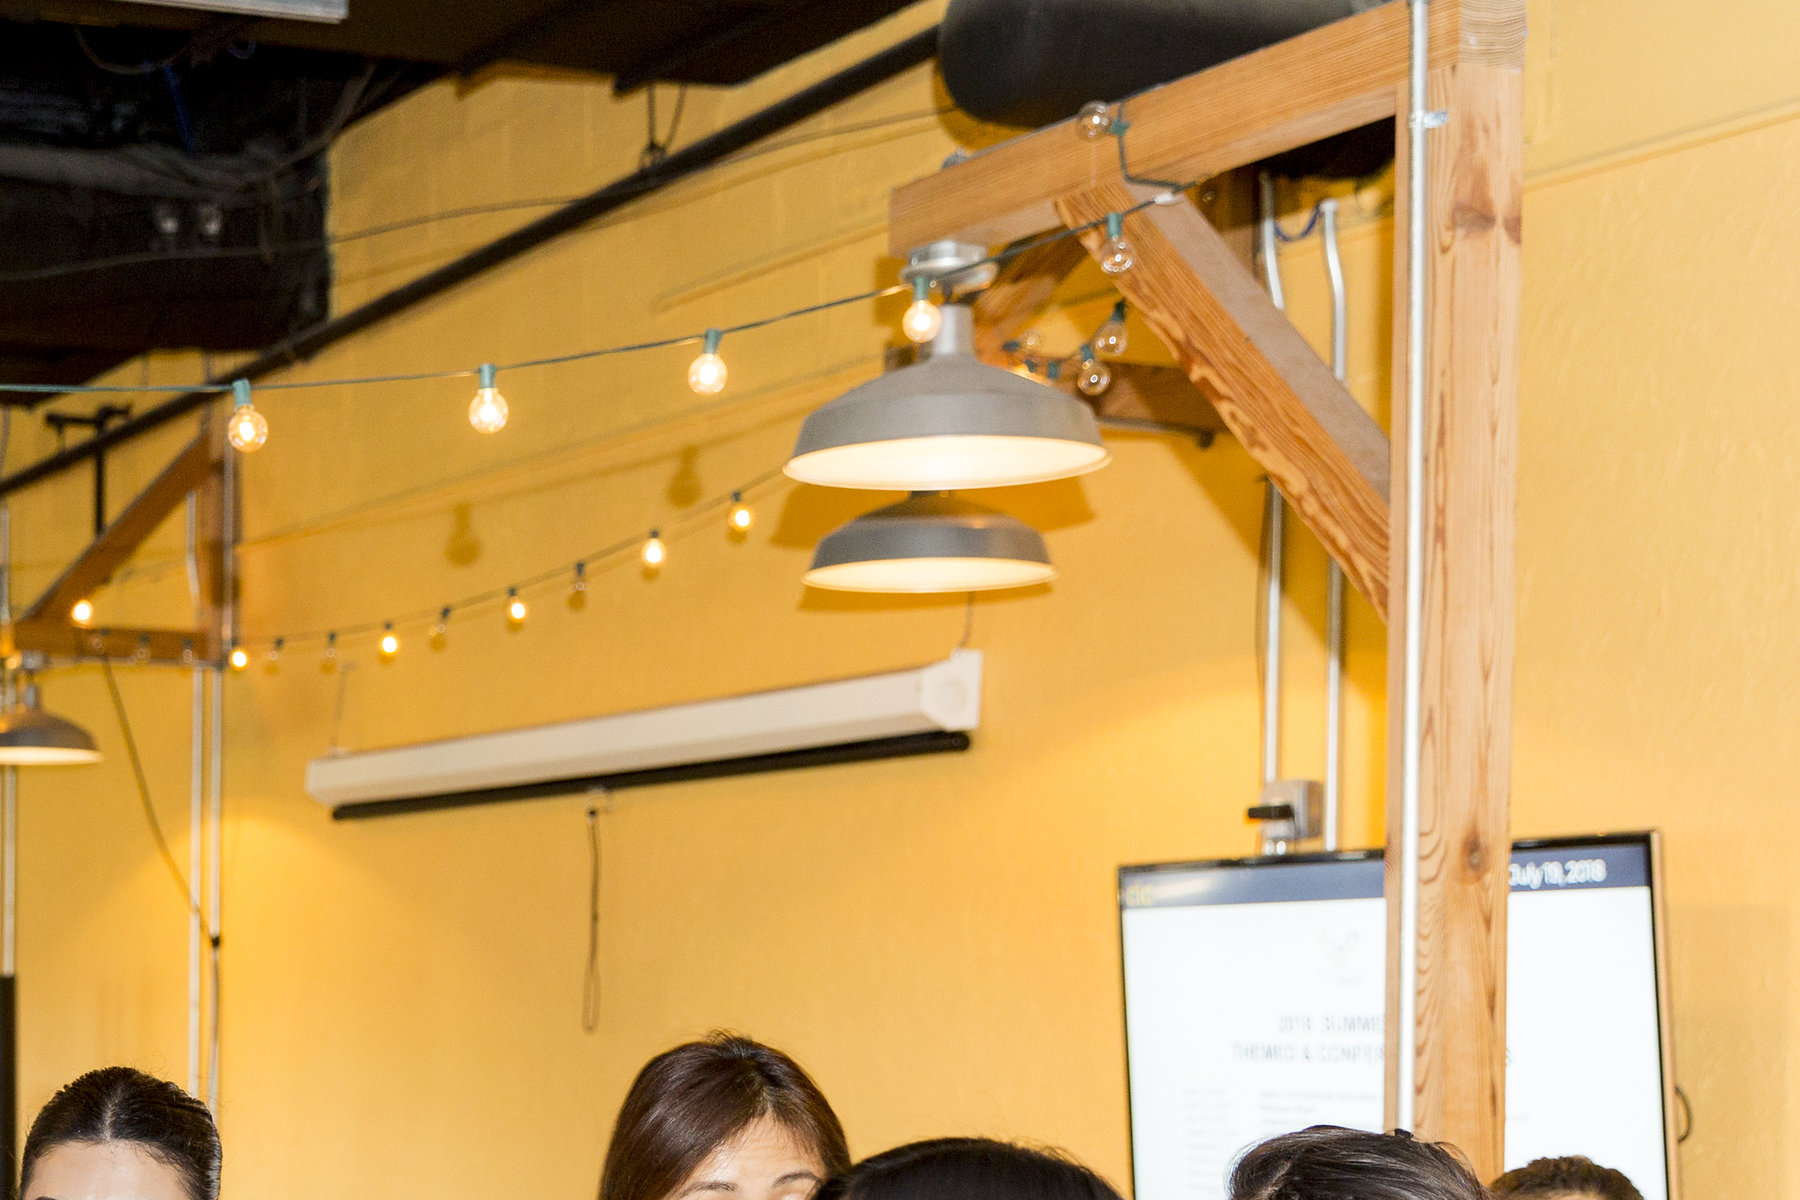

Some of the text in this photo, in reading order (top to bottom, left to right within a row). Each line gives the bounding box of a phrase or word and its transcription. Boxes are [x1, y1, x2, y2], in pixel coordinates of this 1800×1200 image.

[1508, 862, 1543, 889] July
[1565, 859, 1606, 883] 2018
[1319, 1014, 1384, 1033] SUMME
